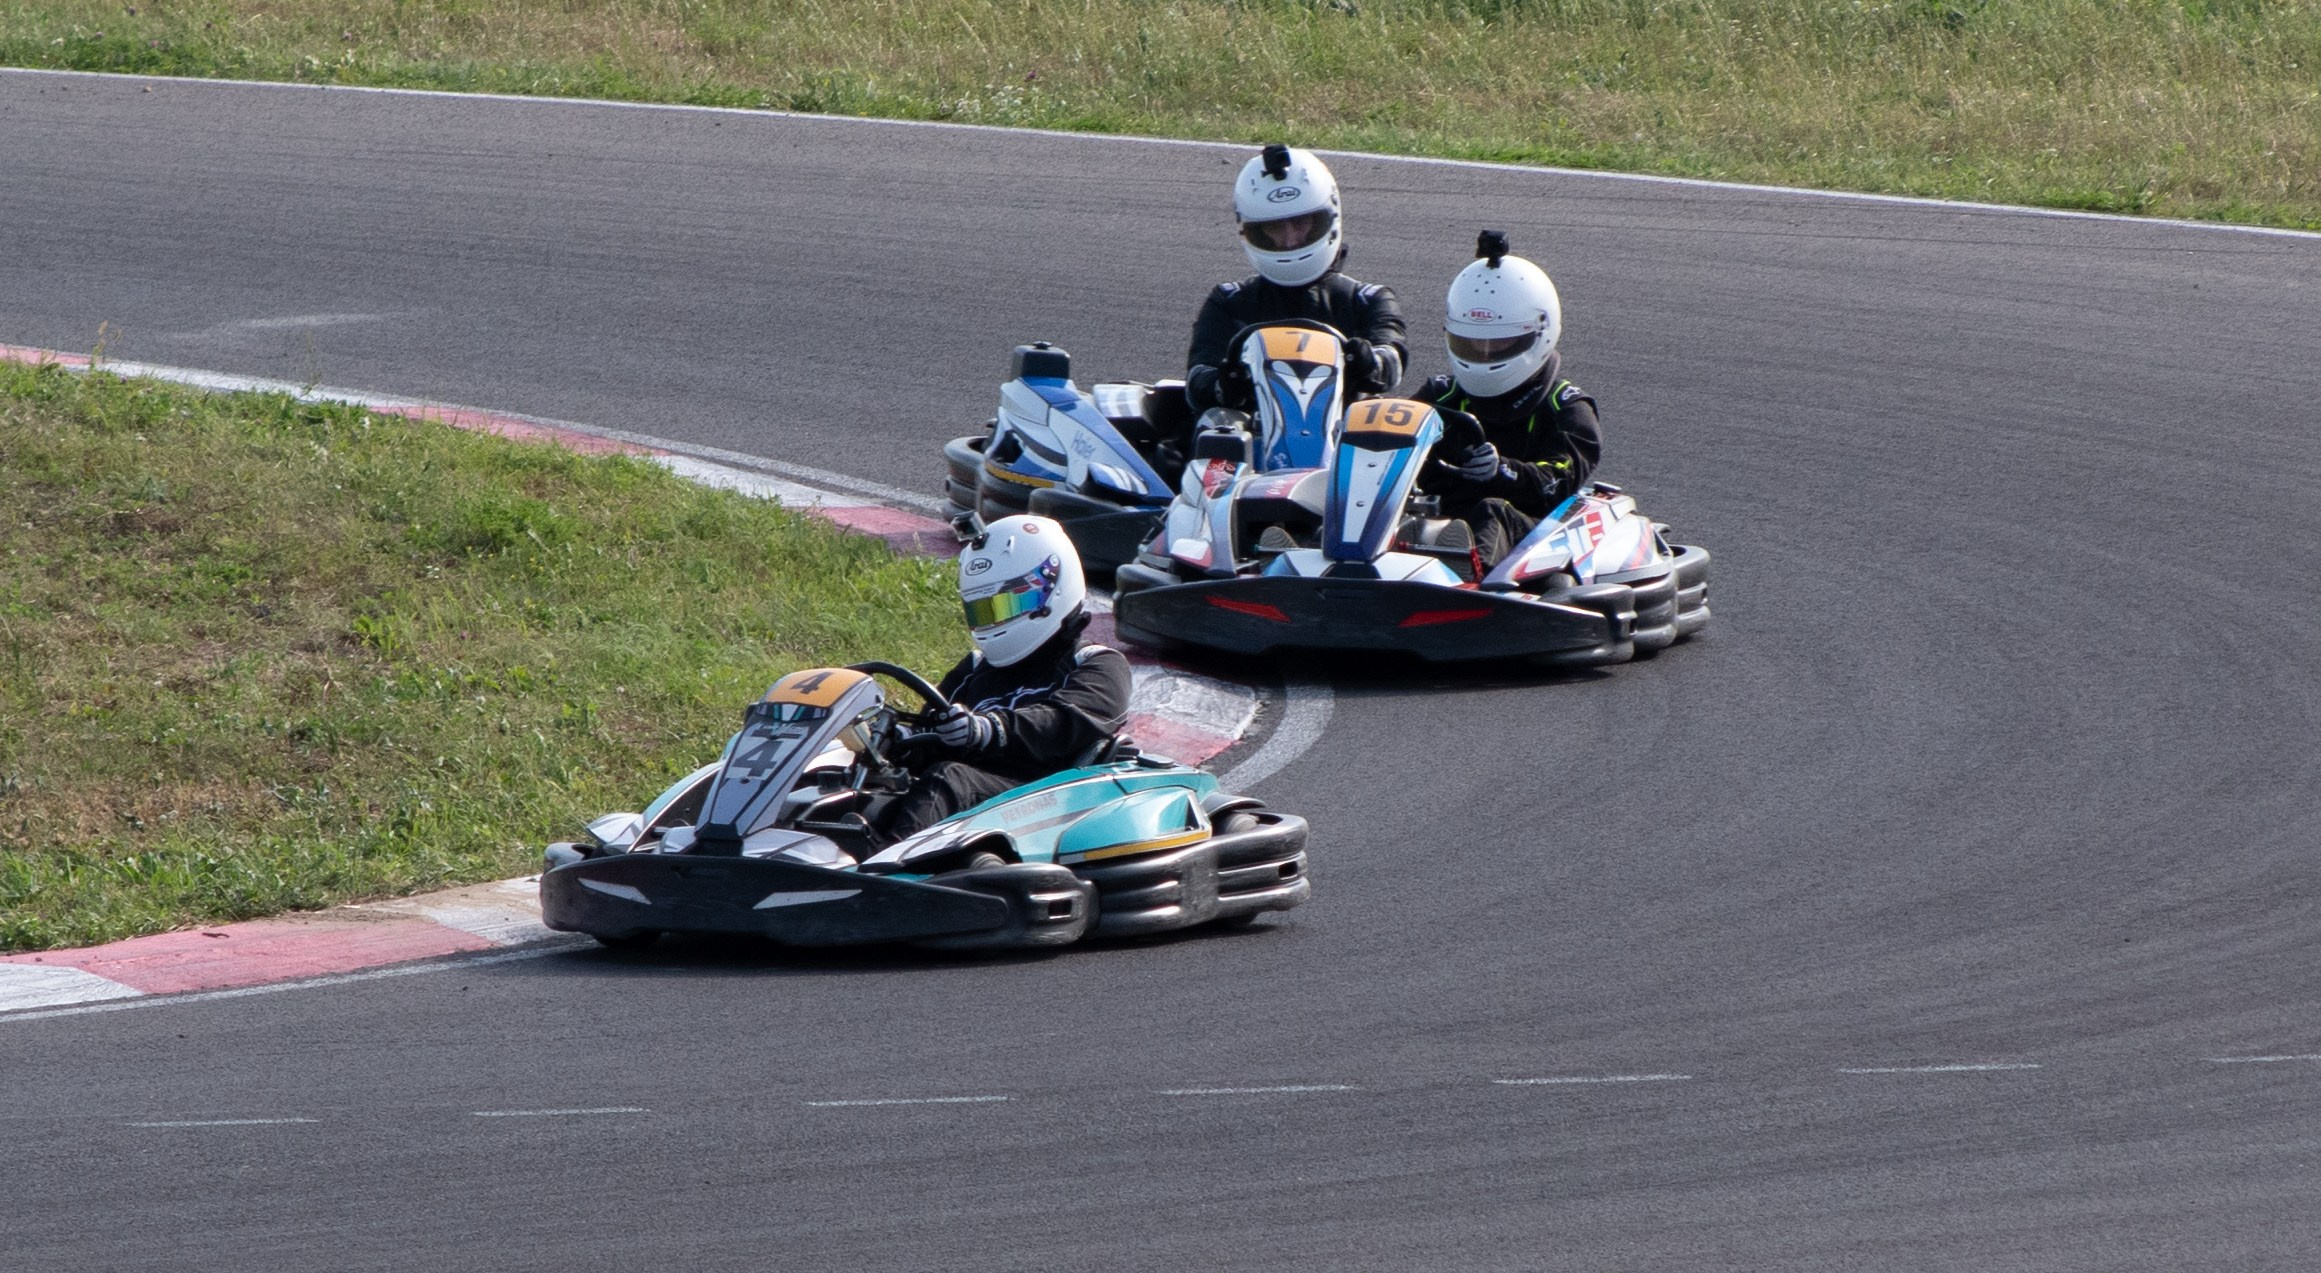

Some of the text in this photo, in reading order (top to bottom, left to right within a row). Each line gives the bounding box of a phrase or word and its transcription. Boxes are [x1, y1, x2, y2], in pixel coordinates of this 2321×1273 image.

[1274, 188, 1296, 199] Arai
[1470, 311, 1492, 319] BELL
[1286, 331, 1311, 352] 7
[1365, 402, 1415, 426] 15
[969, 560, 988, 571] Arai
[790, 672, 834, 694] 4
[732, 741, 783, 777] 4
